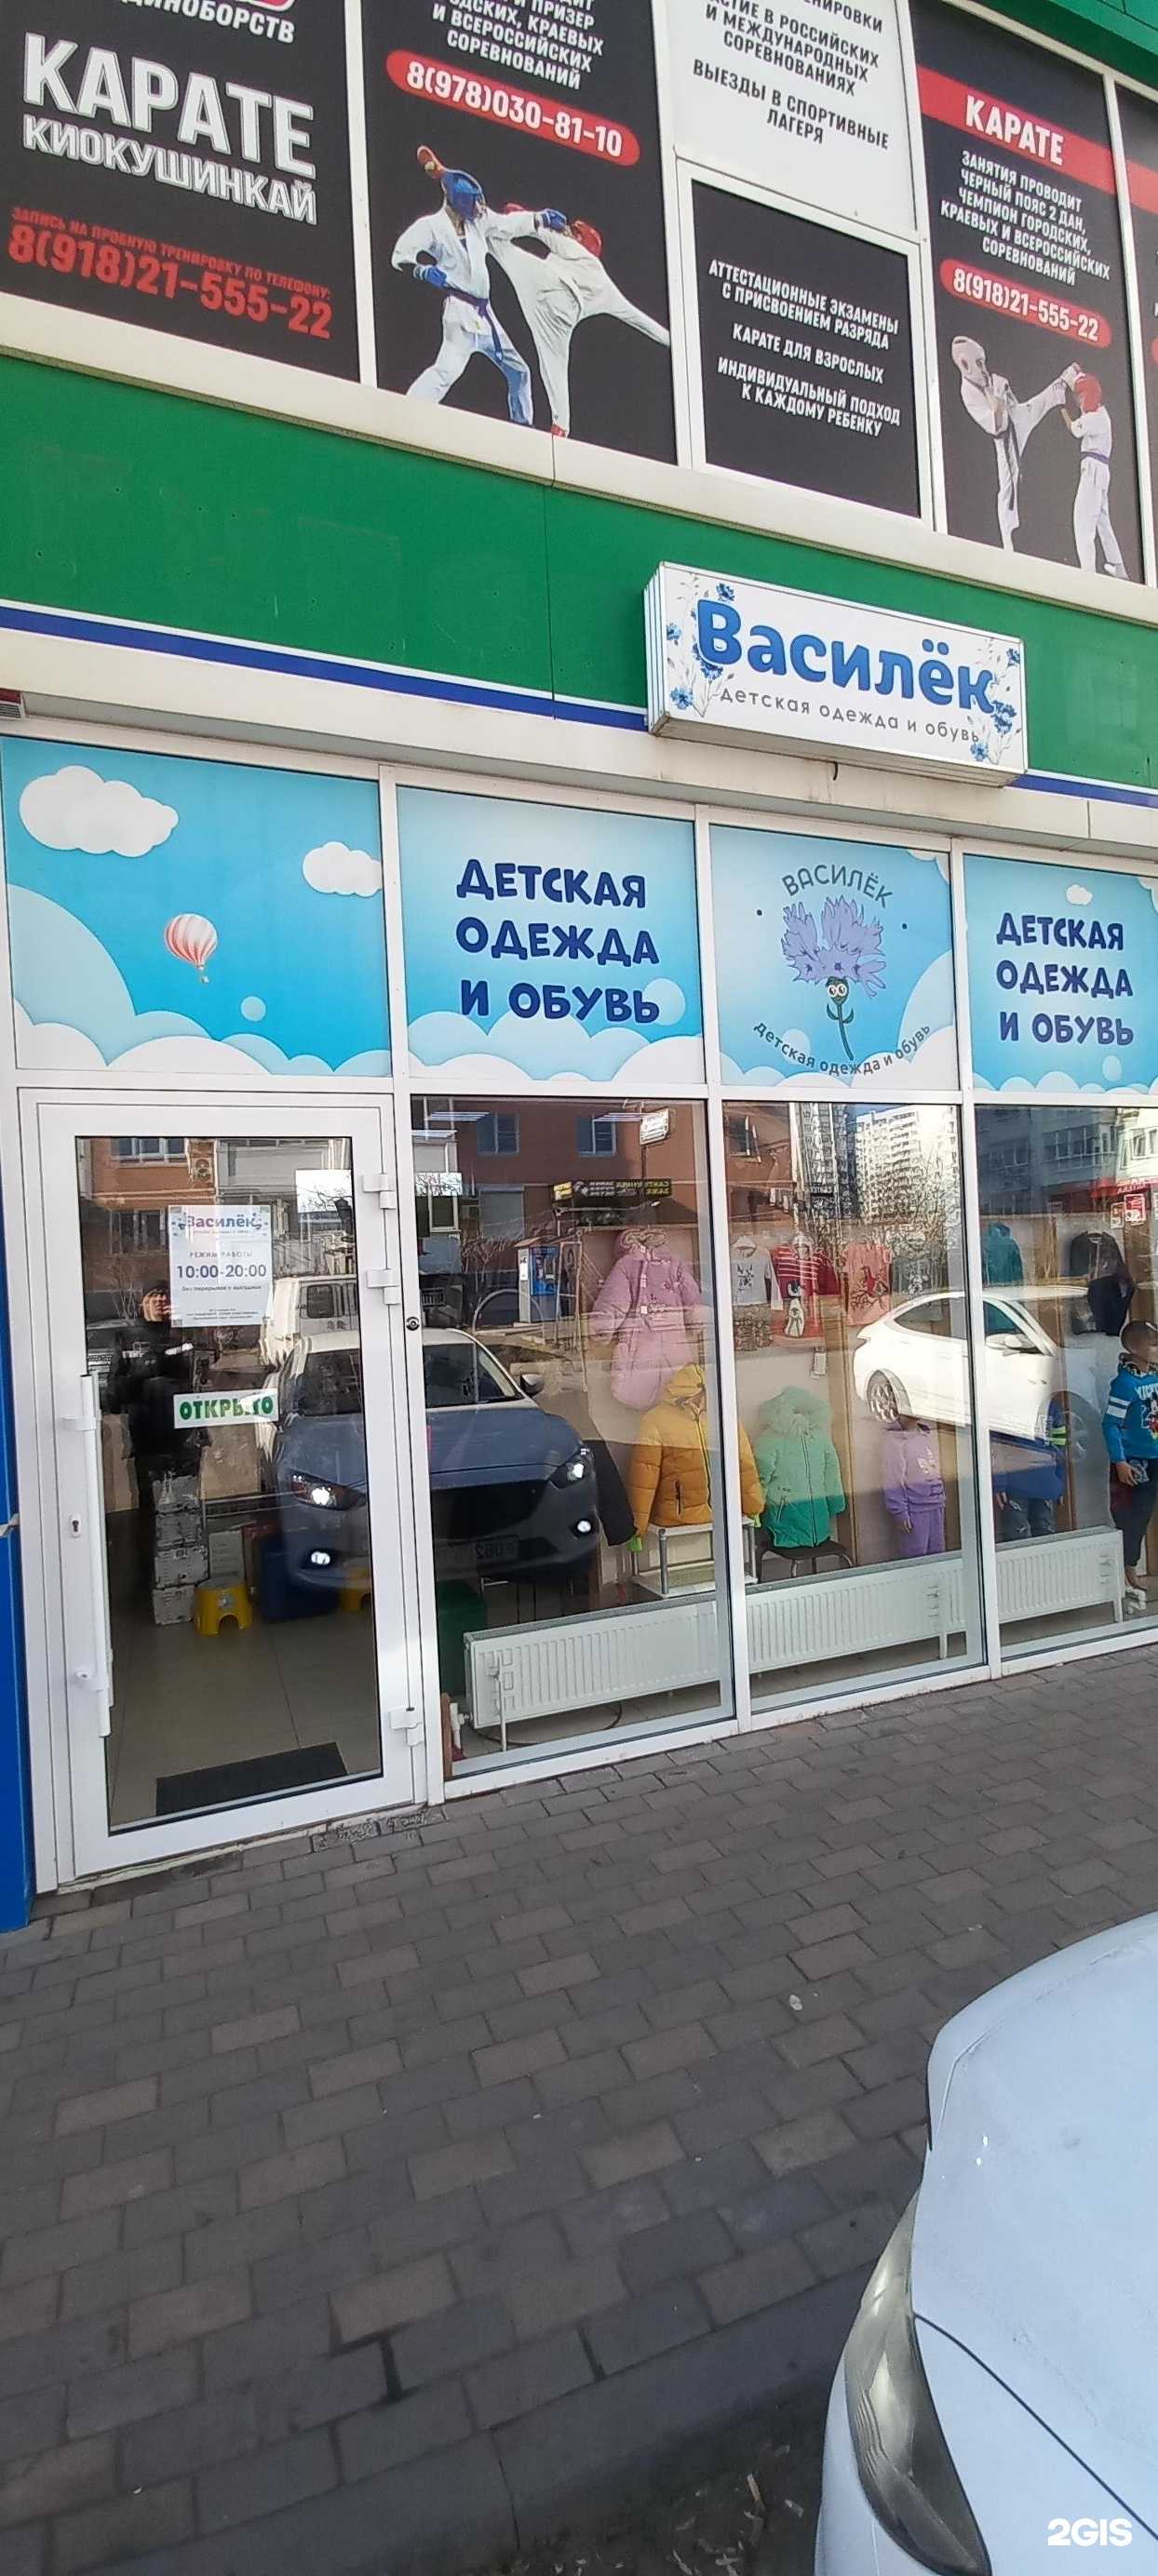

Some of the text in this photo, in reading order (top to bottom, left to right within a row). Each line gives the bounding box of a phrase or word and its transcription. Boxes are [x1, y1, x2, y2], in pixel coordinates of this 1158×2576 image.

[432, 4, 593, 73] И ВСЕРОССИЙСКИХ
[528, 14, 604, 56] КРАЕВЫХ
[532, 0, 595, 31] ПРИЗЕР
[705, 4, 868, 83] И МЕЖДУНАРОДНЫХ
[763, 9, 774, 25] В
[780, 15, 880, 69] РОССИЙСКИХ
[447, 30, 582, 90] СОРЕВНОВАНИЙ
[723, 31, 855, 97] СОРЕВНОВАНИЯХ
[23, 32, 316, 179] КАРАТЕ
[406, 60, 623, 157] 8(978)030-81-10
[693, 59, 889, 150] ВЫЕЗДЫ В СПОРТИВНЫЕ
[767, 109, 824, 144] ЛАГЕРЯ
[965, 94, 1064, 166] КАРАТЕ
[22, 114, 317, 225] КИОКУШИНКАЙ
[962, 150, 1082, 213] ЗАНЯТИЯ ПРОВОДИТ
[959, 187, 1091, 255] ЧЕМПИОН ГОРОДСКИХ,
[961, 168, 1085, 235] ЧЕРНЫЙ ПОЯС 2 ДАН,
[70, 220, 88, 235] НА
[245, 266, 263, 282] ПО
[941, 200, 1111, 280] КРАЕВЫХ И ВСЕРОССИЙСКИХ
[982, 236, 1075, 286] СОРЕВНОВАНИЙ
[8, 224, 333, 339] 8(918)21-555-22
[708, 259, 898, 335] АТТЕСТАЦИОННЫЕ ЭКЗАМЕНЫ
[953, 268, 1098, 342] 8(918)21-555-22
[721, 282, 889, 351] С ПРИСВОЕНИЕМ РАЗРЯДА
[733, 322, 884, 384] КАРАТЕ ДЛЯ ВЗРОСЛЫХ
[718, 356, 900, 426] ИНДИВИДУАЛЬНЫЙ ПОДХОД
[742, 382, 882, 437] К КАЖДОМУ РЕБЕНКУ
[697, 598, 995, 715] Василёк
[720, 687, 980, 745] детская одежда и обувь
[456, 859, 646, 908] ДЕТСКАЯ
[781, 864, 894, 908] ВАСИЛЁК
[455, 917, 660, 967] ОДЕЖДА
[996, 912, 1124, 950] ДЕТСКАЯ
[461, 979, 660, 1024] И ОБУВЬ
[996, 959, 1134, 1000] ОДЕЖДА
[753, 1022, 932, 1076] детская одежда и обувь
[999, 1011, 1134, 1046] И ОБУВЬ
